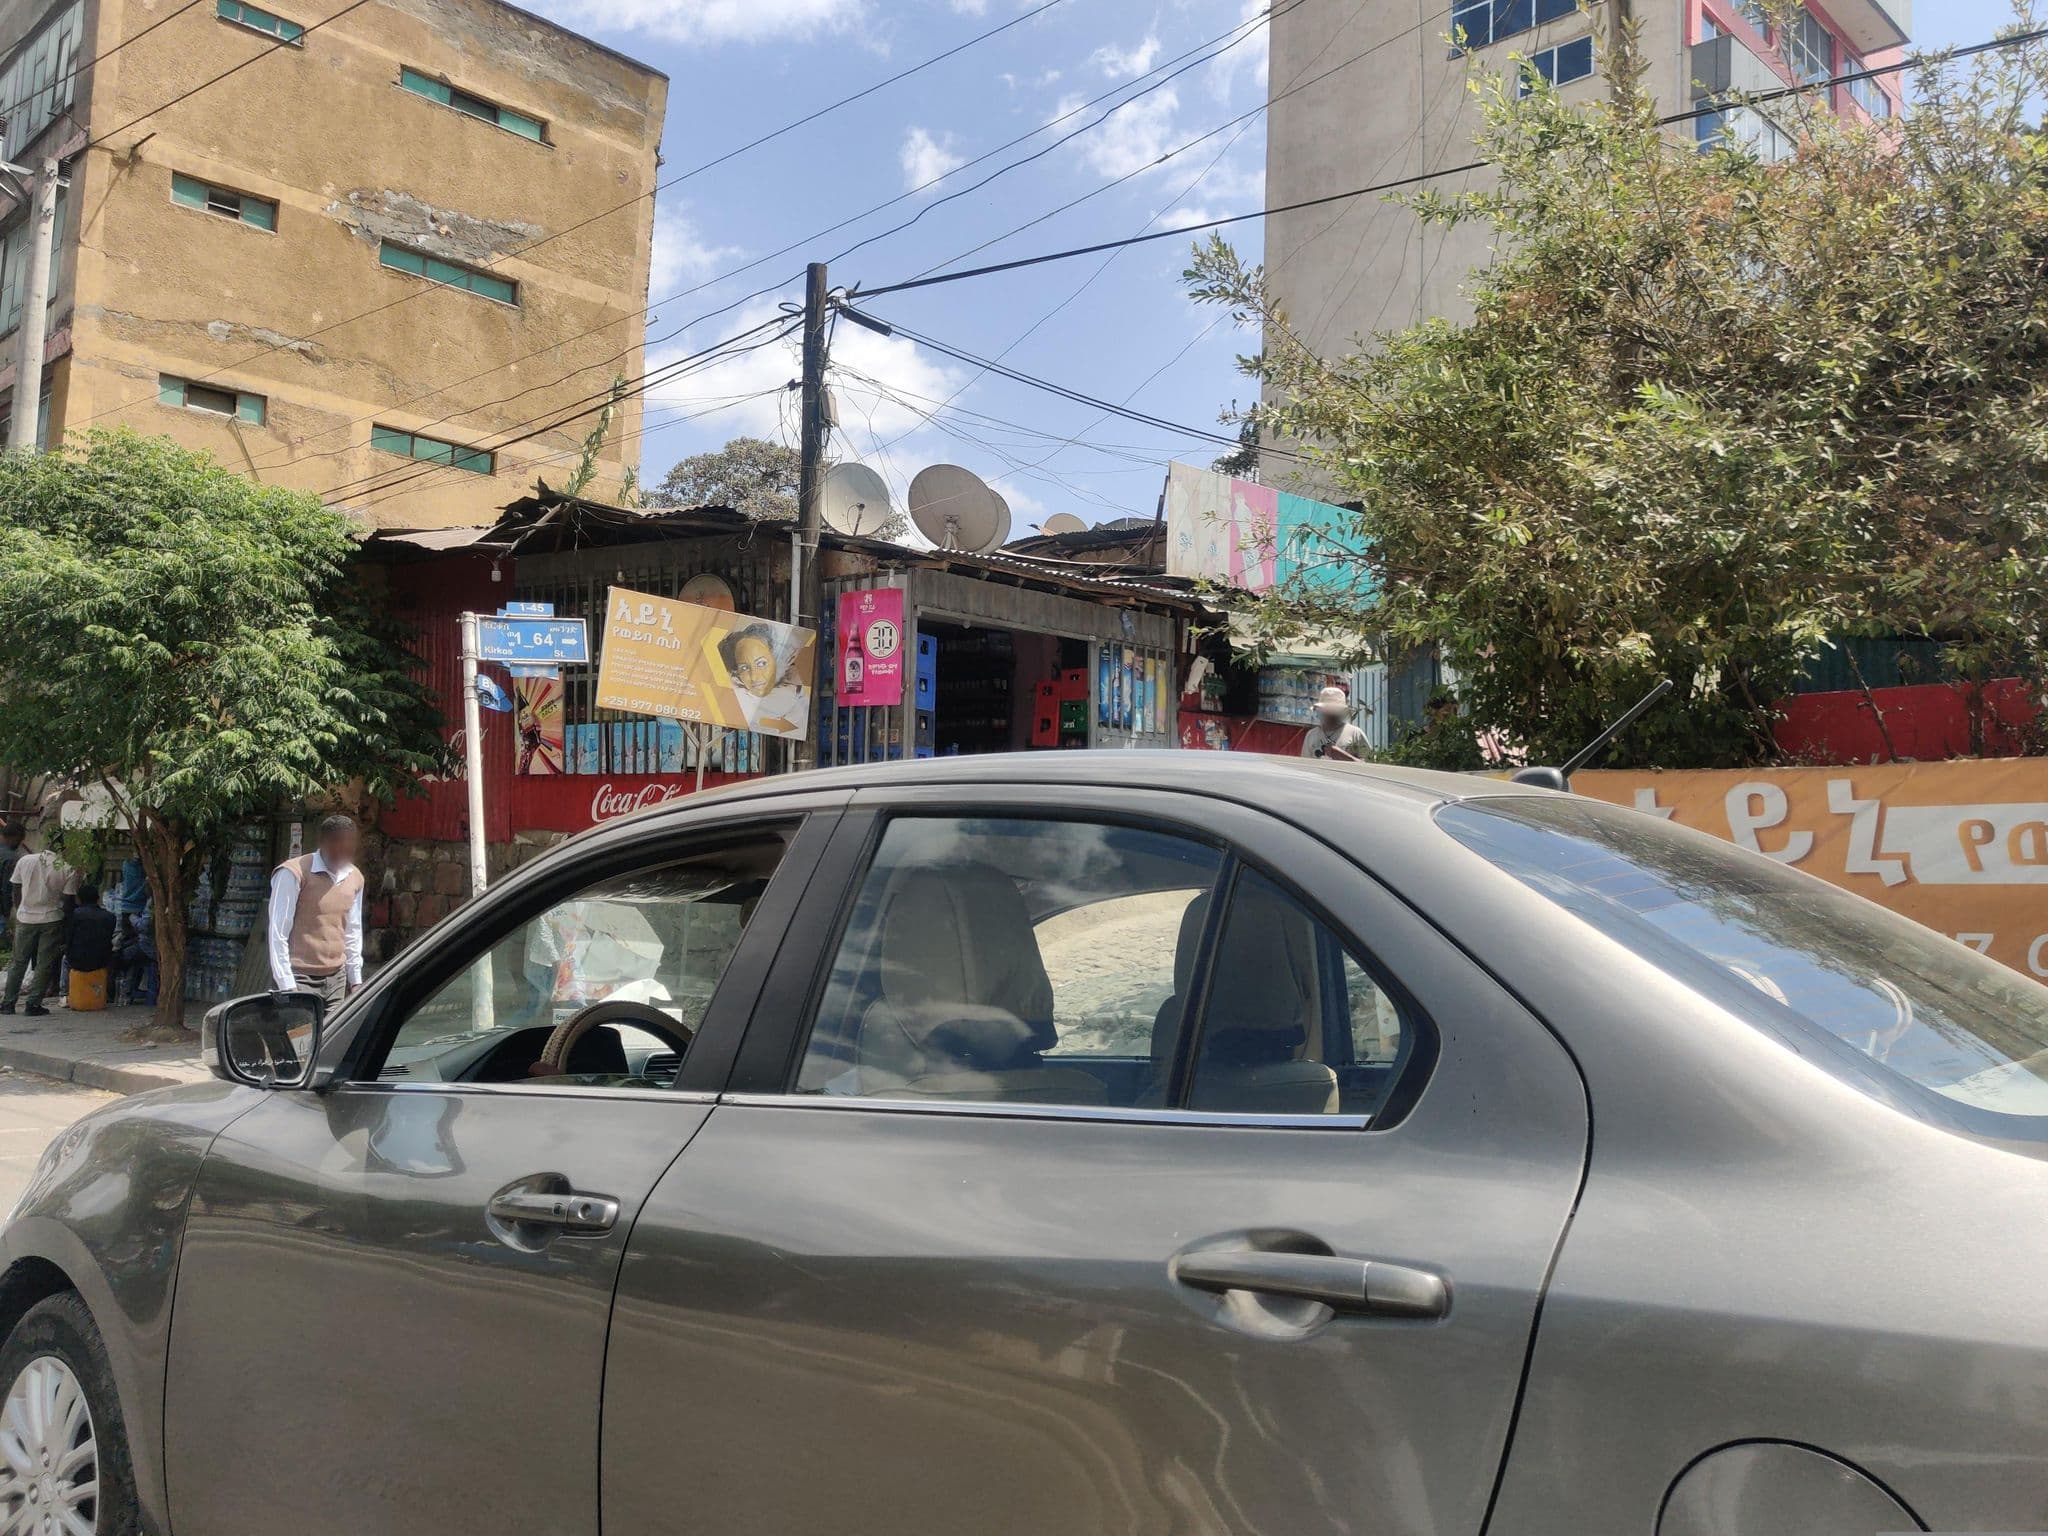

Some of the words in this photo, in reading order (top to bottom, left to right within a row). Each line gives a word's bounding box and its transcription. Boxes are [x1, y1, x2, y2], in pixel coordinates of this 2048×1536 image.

[484, 645, 513, 656] Kirkos
[602, 695, 628, 707] +251
[630, 699, 652, 711] 977
[655, 704, 678, 715] 080
[680, 708, 702, 720] 822
